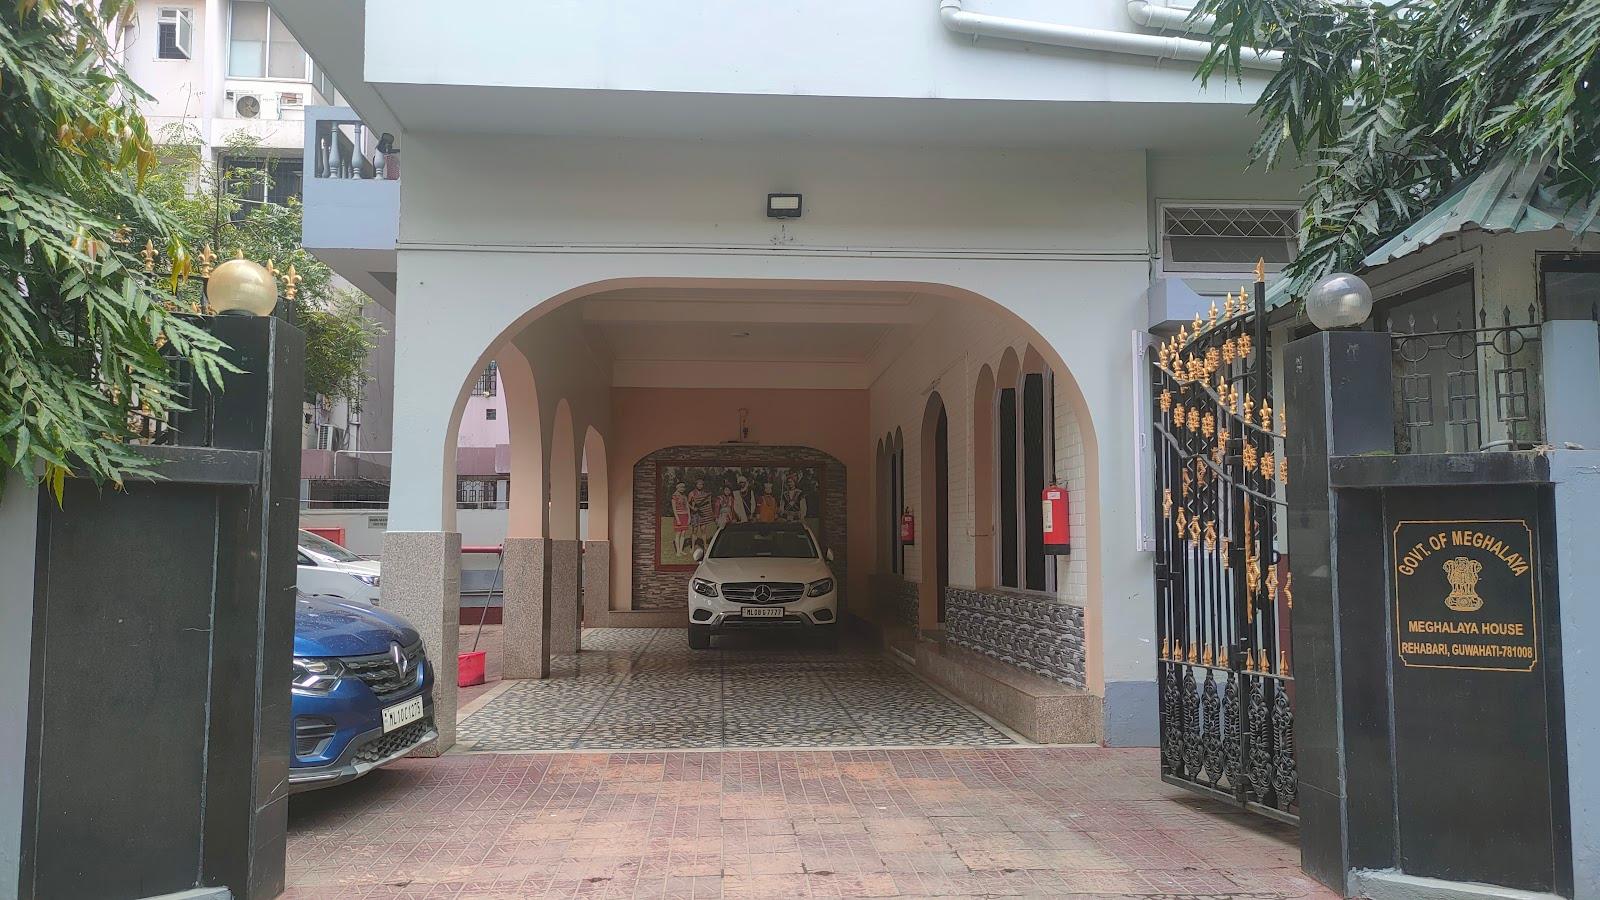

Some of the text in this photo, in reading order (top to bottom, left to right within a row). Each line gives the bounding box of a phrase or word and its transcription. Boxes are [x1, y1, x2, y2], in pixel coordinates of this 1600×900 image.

[1398, 530, 1529, 577] GOVT. OF MEGHALAYA
[1408, 620, 1525, 636] MEGHALAYA HOUSE
[1401, 641, 1533, 659] REHABARI, GUWAHATI-781008
